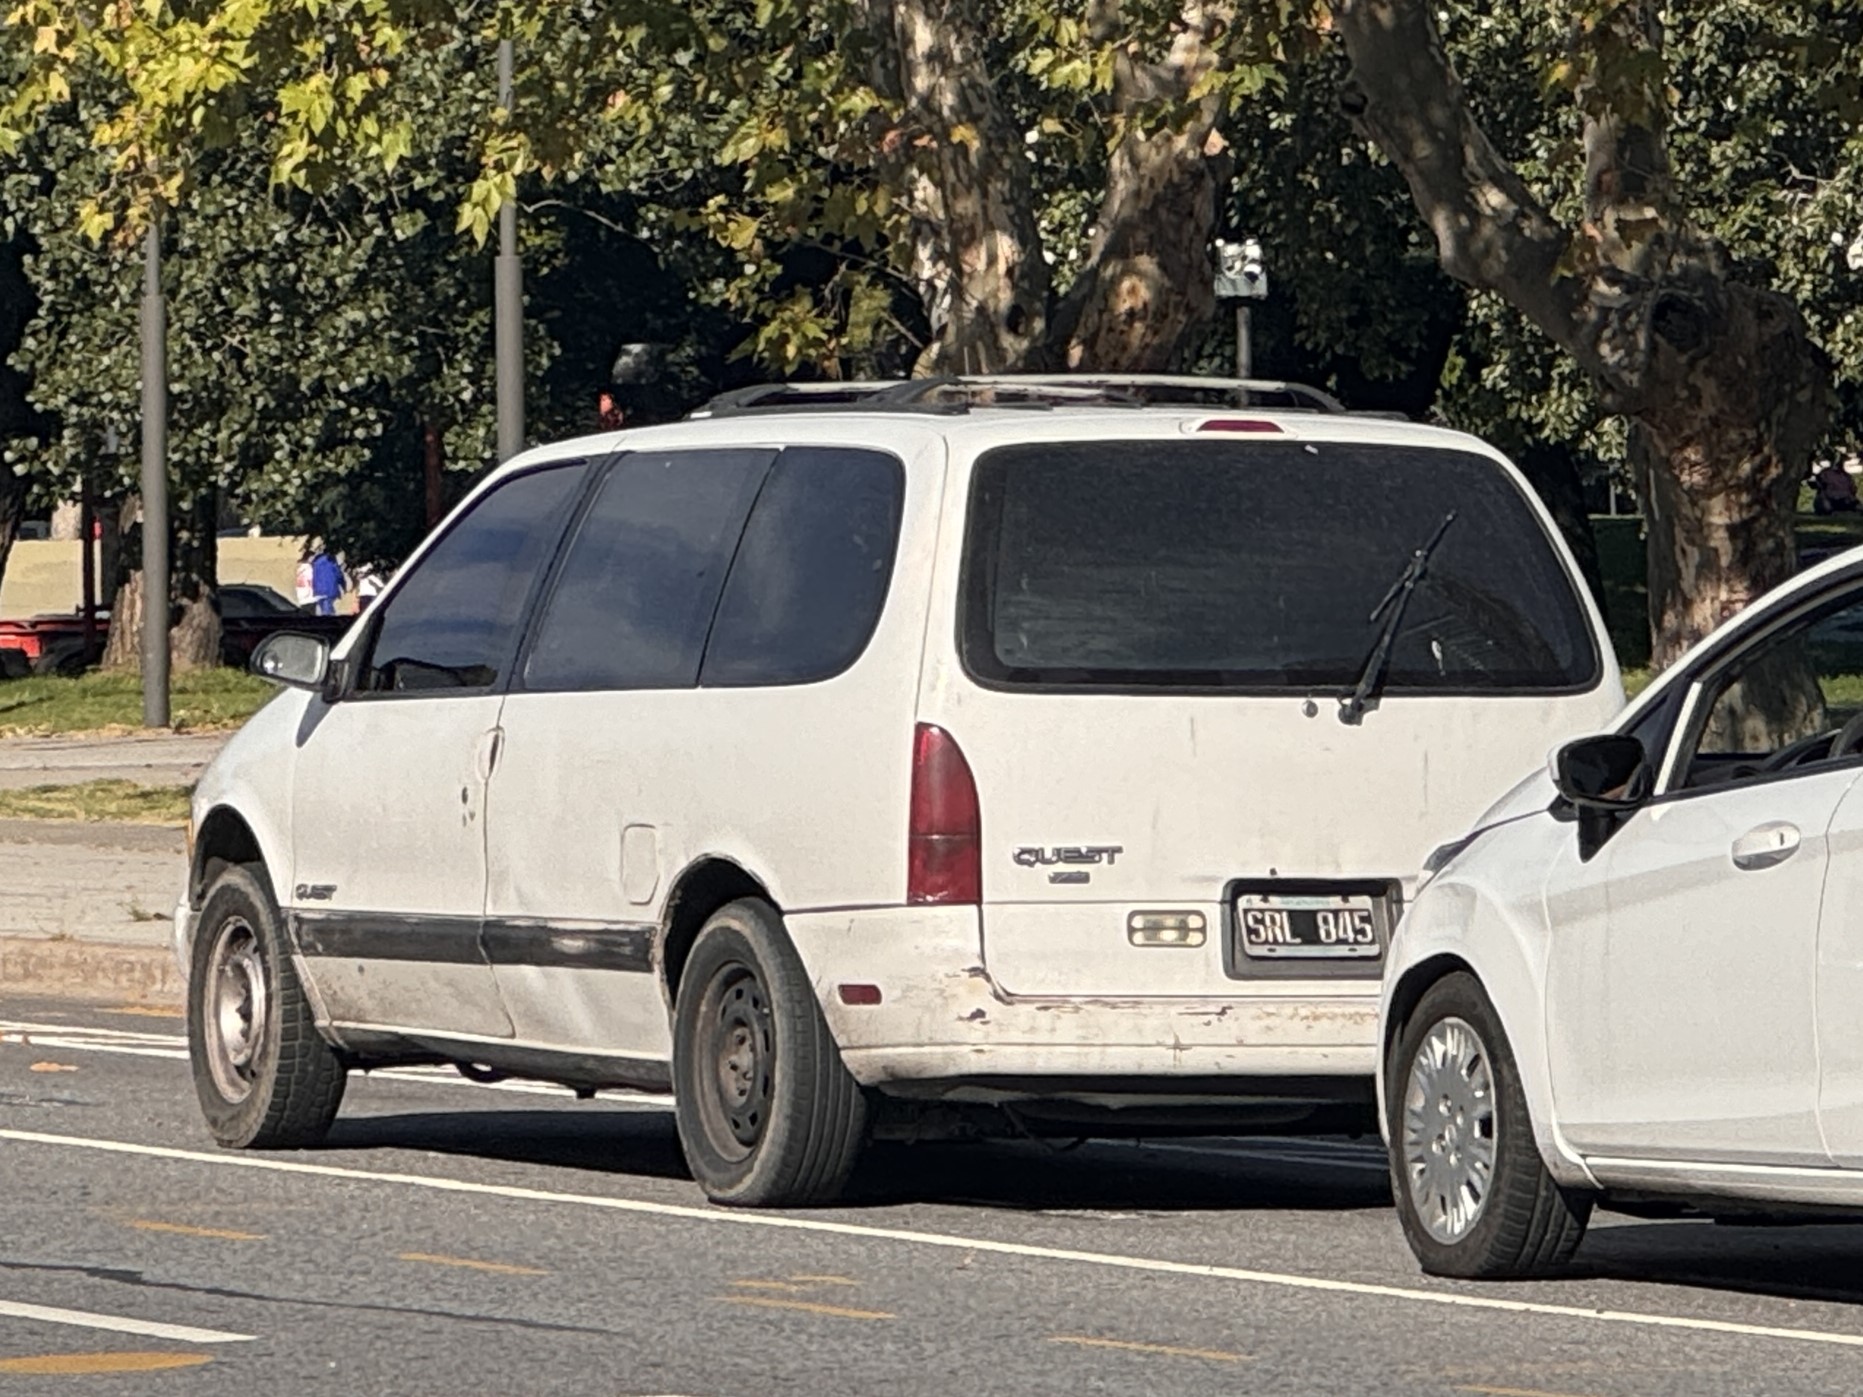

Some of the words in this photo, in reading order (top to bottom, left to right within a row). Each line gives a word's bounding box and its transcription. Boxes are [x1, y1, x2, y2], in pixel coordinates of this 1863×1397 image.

[1013, 846, 1123, 868] QUEST
[1247, 911, 1302, 944] SRL
[1316, 911, 1373, 944] 845
